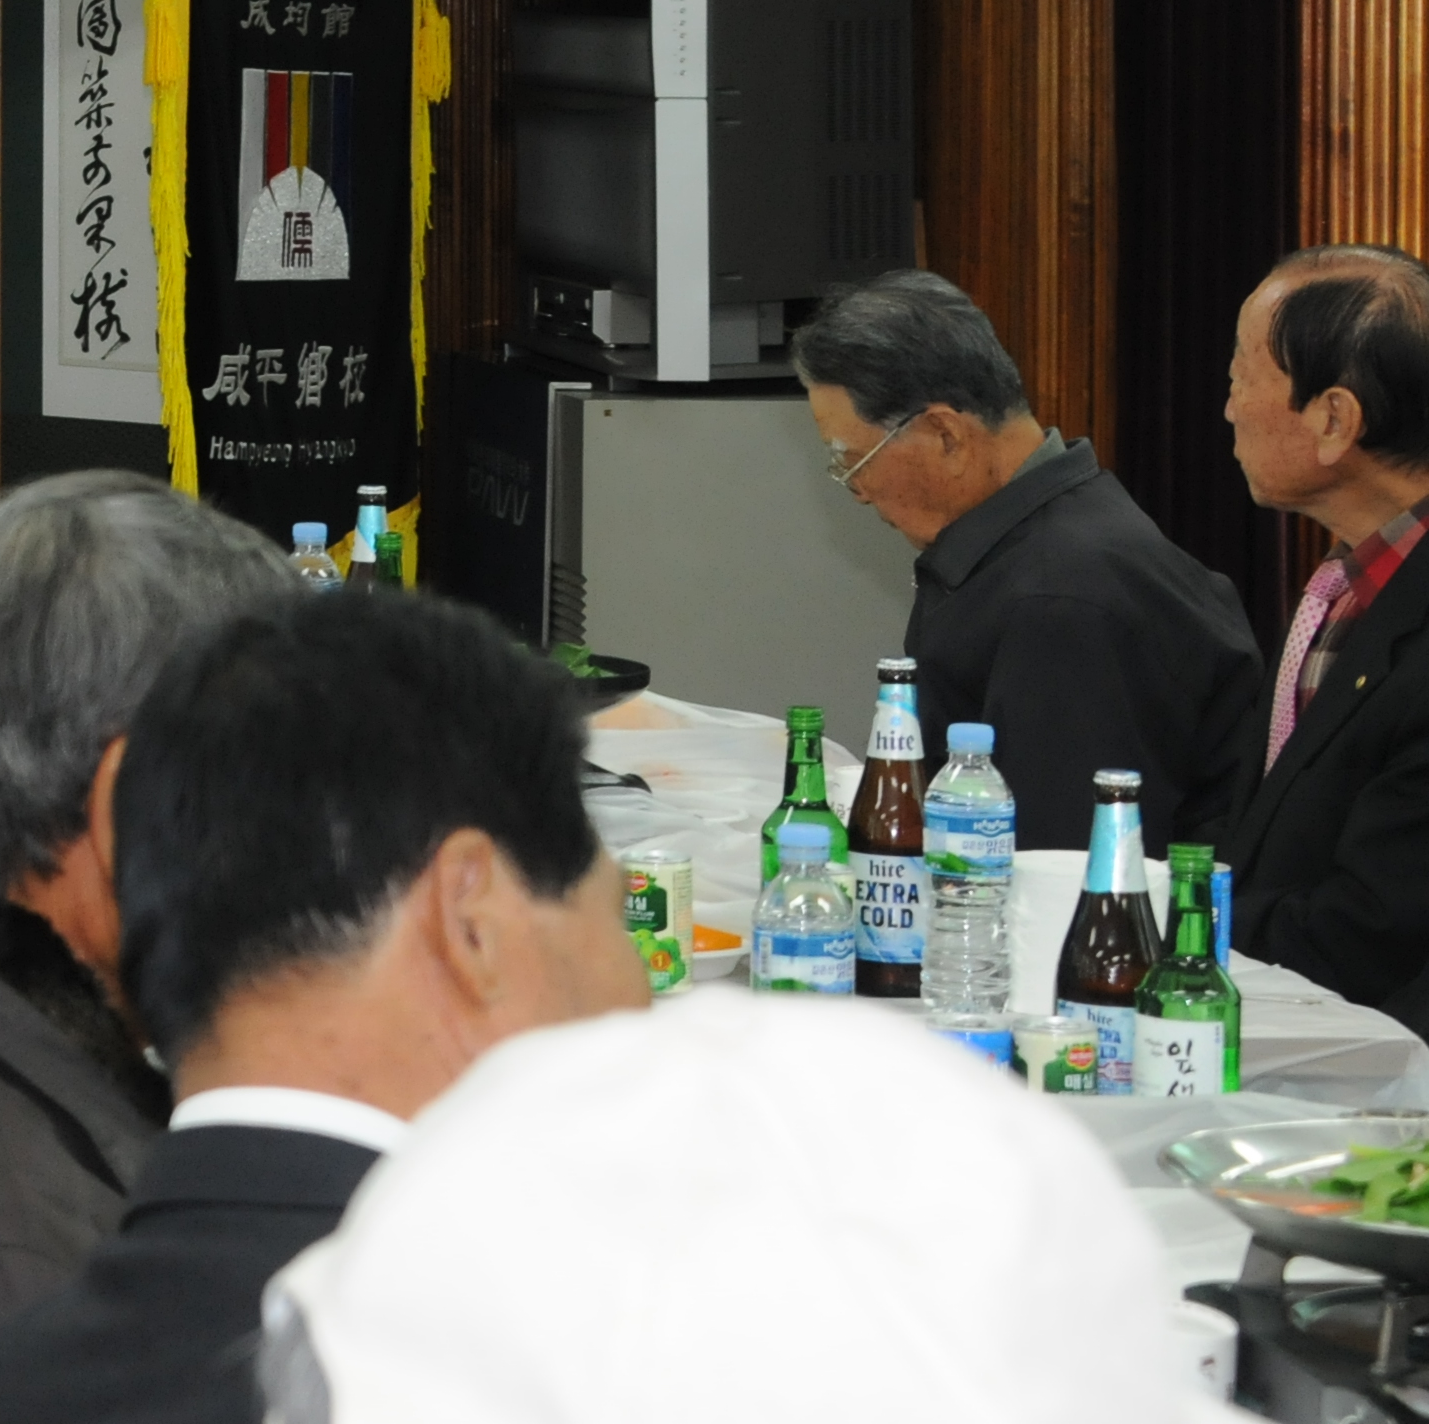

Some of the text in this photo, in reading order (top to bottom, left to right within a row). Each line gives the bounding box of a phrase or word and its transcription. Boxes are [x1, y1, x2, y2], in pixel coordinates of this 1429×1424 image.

[876, 730, 916, 752] hite
[869, 859, 906, 879] hite
[855, 879, 920, 904] EXTRA
[860, 905, 914, 929] COLD
